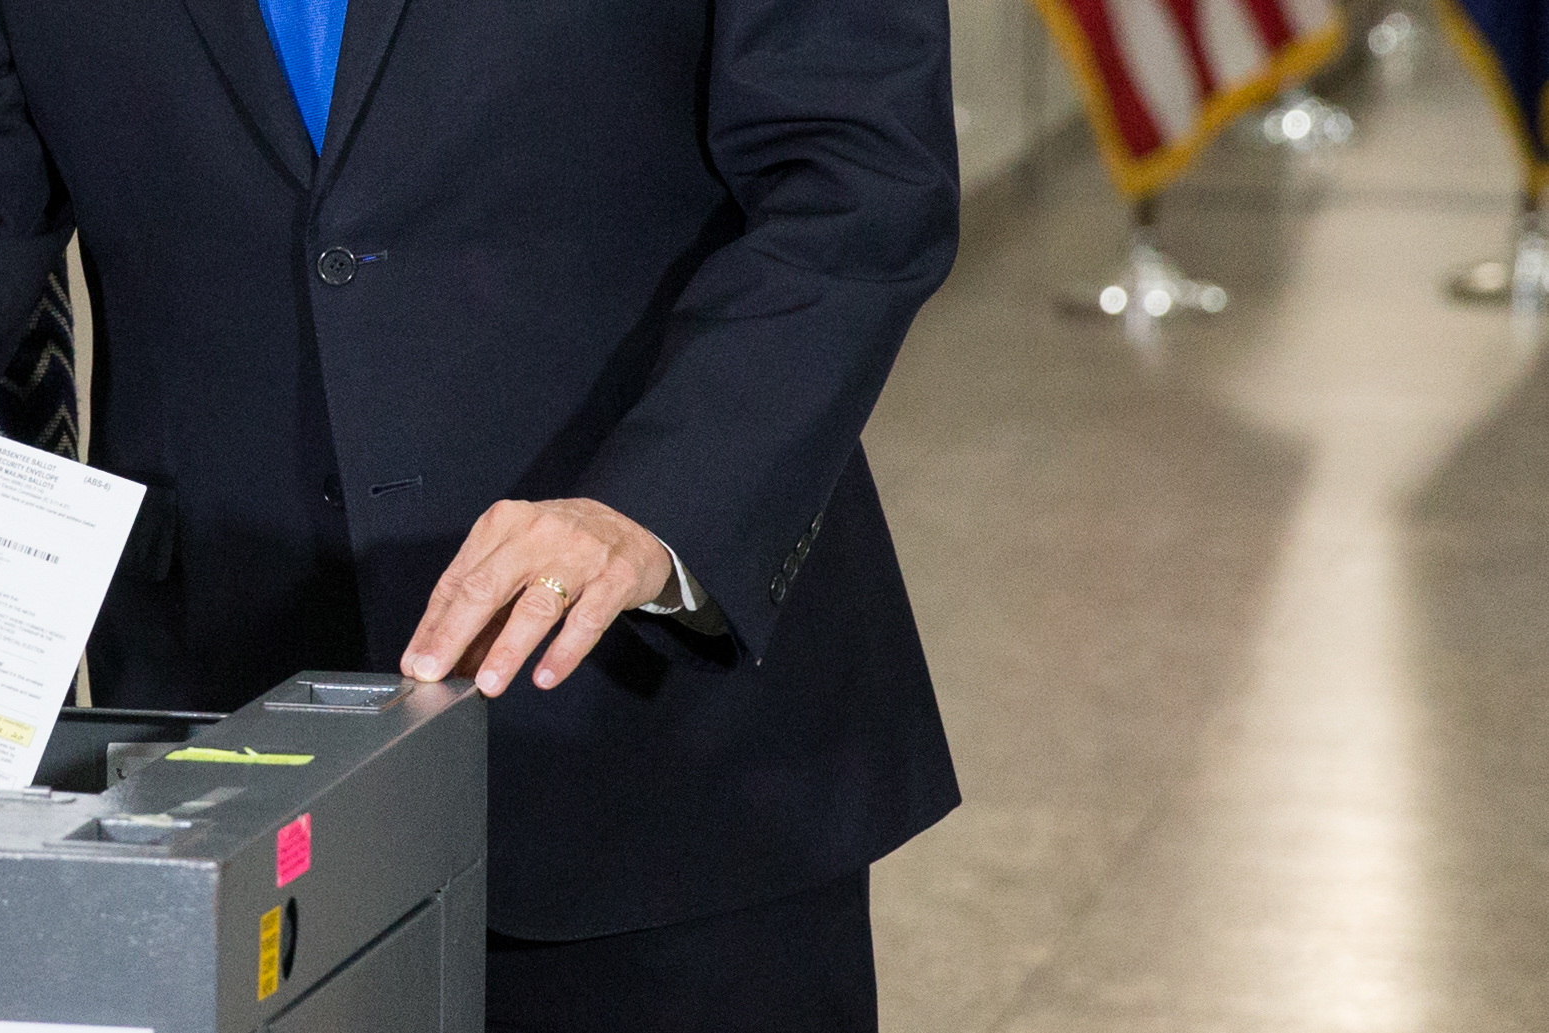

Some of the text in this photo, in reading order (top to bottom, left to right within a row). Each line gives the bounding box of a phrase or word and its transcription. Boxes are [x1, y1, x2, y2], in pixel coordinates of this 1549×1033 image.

[31, 459, 56, 471] BALLOT
[4, 469, 27, 481] MAILING
[28, 476, 54, 490] BALLOTS
[25, 466, 59, 483] ENVELOPE
[84, 476, 111, 491] (ABS-6)
